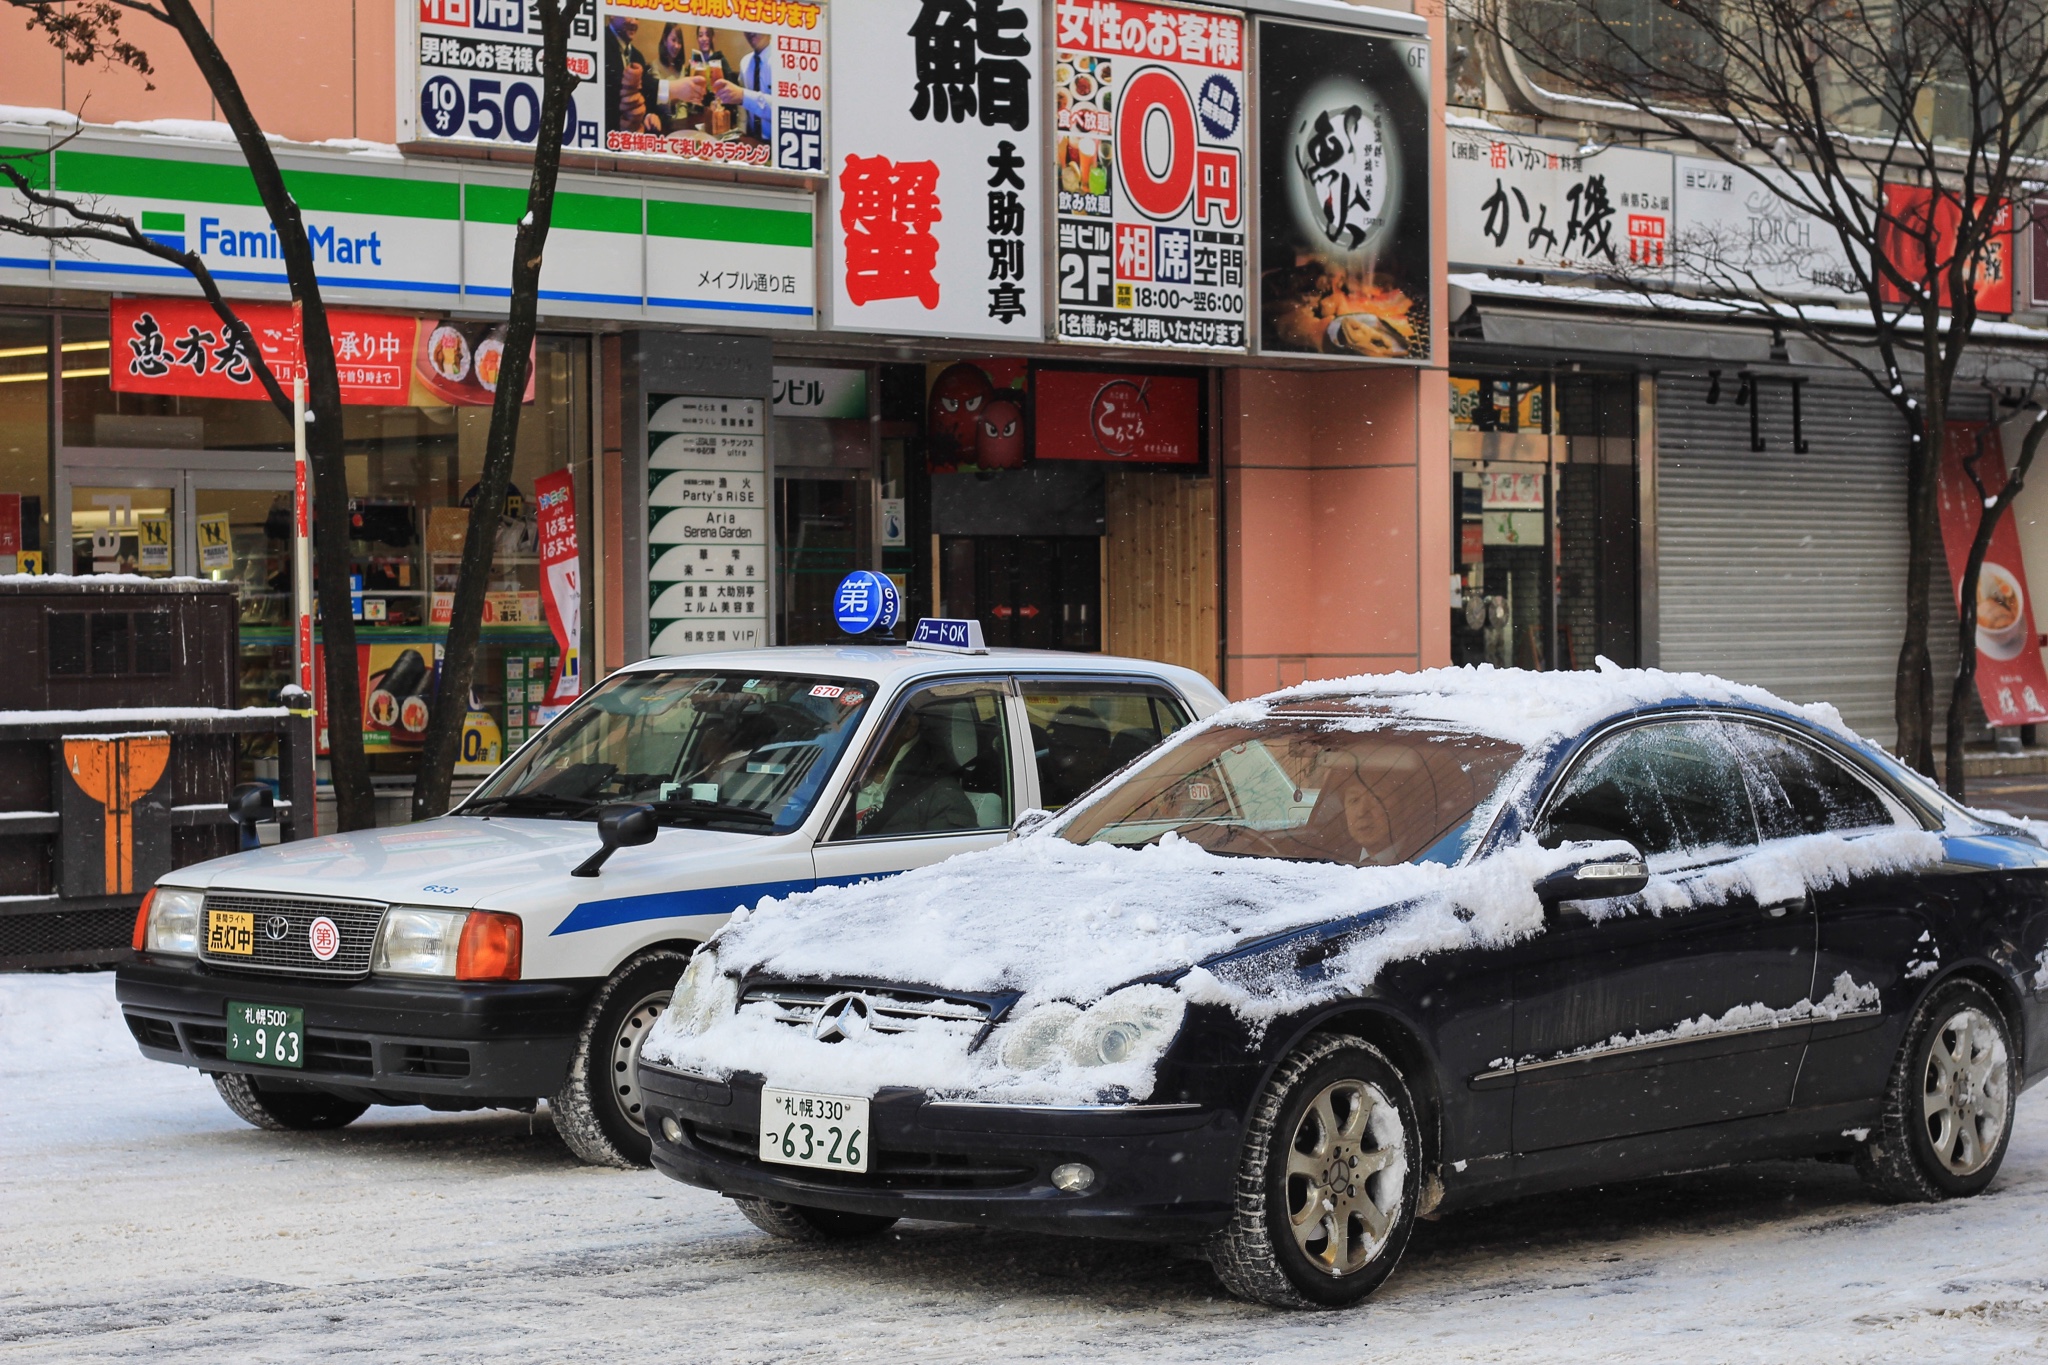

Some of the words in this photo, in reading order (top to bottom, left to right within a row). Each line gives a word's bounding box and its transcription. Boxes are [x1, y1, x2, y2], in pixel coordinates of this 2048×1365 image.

[1058, 2, 1240, 66] 女性のお客様
[421, 37, 533, 74] 男性のお客様
[780, 38, 820, 53] 営業時間
[781, 54, 819, 72] 18:00
[1407, 47, 1427, 69] 6F
[429, 81, 457, 111] 10
[778, 81, 821, 101] 翌6:00
[780, 110, 820, 131] 当ビル
[1058, 110, 1112, 132] 食べ放題
[607, 131, 771, 164] お客様同士で楽しめるラウンジ
[781, 132, 819, 168] 2F
[1116, 66, 1241, 226] 0円
[1686, 174, 1718, 189] 当ビル
[1722, 174, 1734, 191] 2F
[1058, 192, 1112, 213] 飲み放題
[1481, 173, 1616, 265] かみ磯
[200, 217, 382, 266] FamiMart
[987, 140, 1026, 324] 大助別亭
[1060, 223, 1110, 250] 当ビル
[1748, 216, 1811, 248] TORCH
[1119, 226, 1243, 288] 相席空間
[698, 271, 796, 294] メイプル通り店
[1060, 253, 1111, 301] 2F
[1059, 312, 1242, 345] 1名様からご利用いただけます
[128, 312, 254, 385] 恵方巻
[683, 489, 723, 503] Party's
[706, 511, 736, 524] Aria
[684, 525, 717, 538] Serena
[719, 525, 752, 538] Garden
[717, 586, 755, 597] 大助別亭
[838, 579, 873, 623] 第一
[684, 602, 755, 613] エルム美容室
[684, 631, 726, 642] 相席空間
[732, 631, 754, 641] VIP
[918, 622, 966, 643] カードOK
[813, 686, 840, 697] 670
[423, 884, 459, 894] 633
[216, 913, 246, 923] 昼間ライト
[210, 924, 251, 951] 点灯中
[316, 928, 331, 949] 第一
[782, 1122, 861, 1165] 63-26
